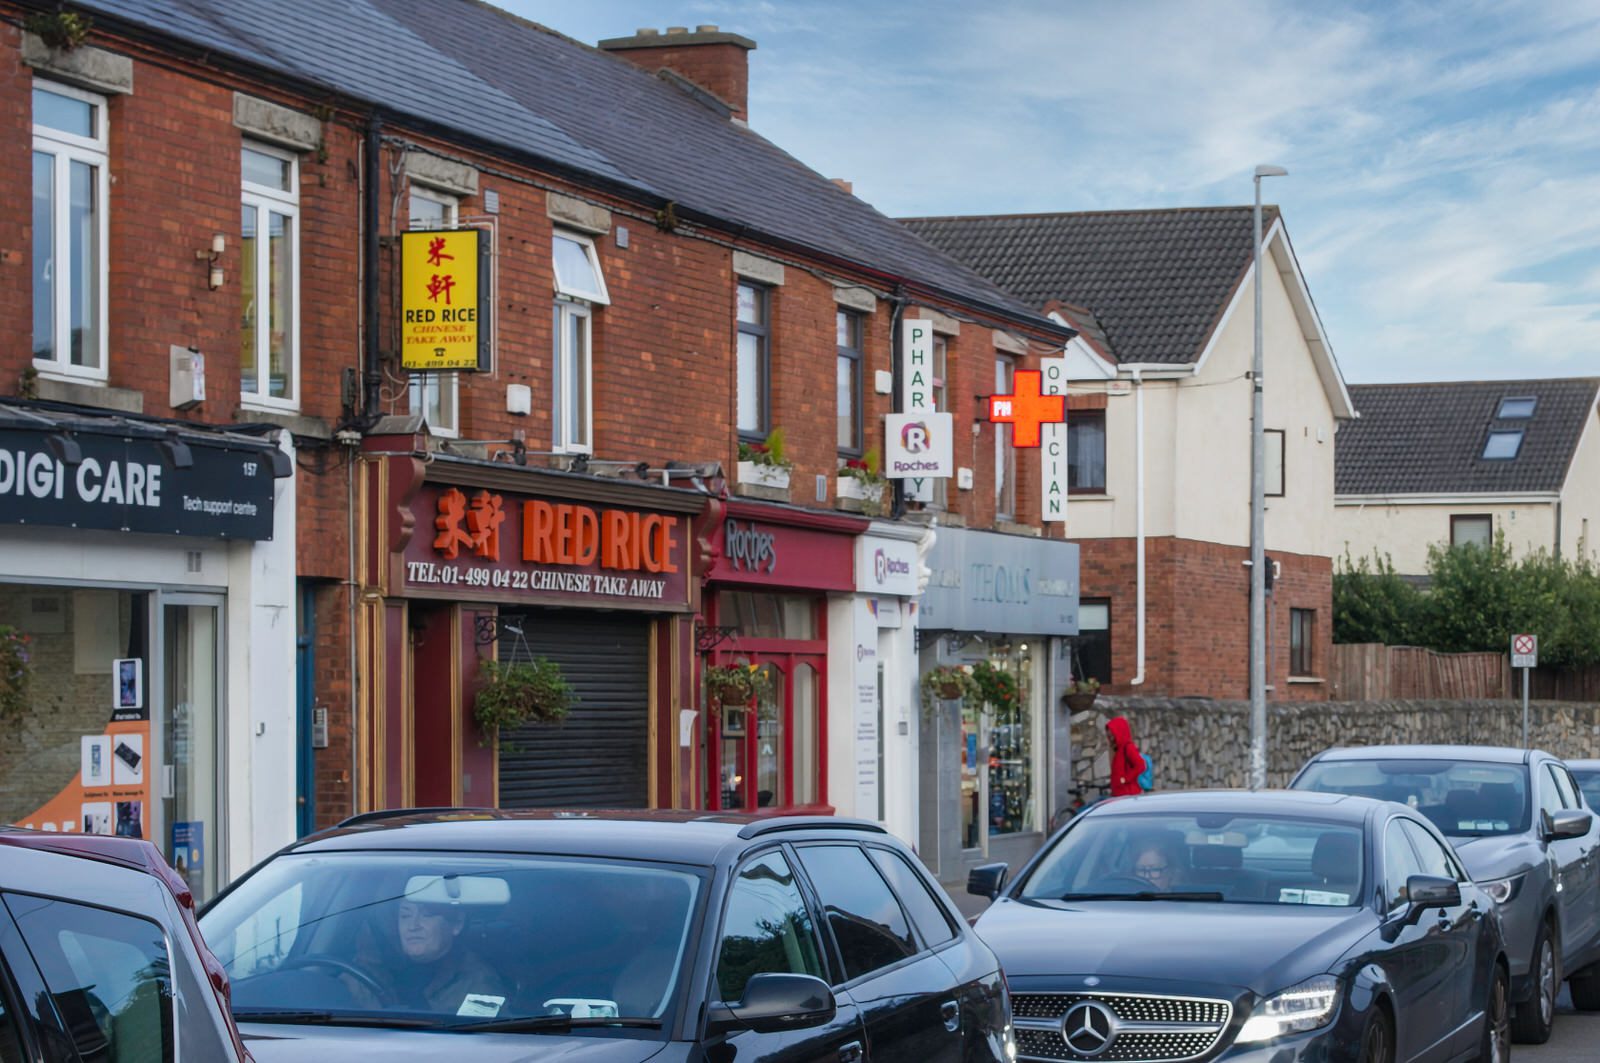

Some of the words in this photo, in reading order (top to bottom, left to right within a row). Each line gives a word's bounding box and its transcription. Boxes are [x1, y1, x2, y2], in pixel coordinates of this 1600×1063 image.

[406, 309, 436, 323] RED
[442, 308, 476, 322] RICE
[406, 335, 436, 344] TAKE
[439, 334, 475, 343] AWAY
[413, 324, 467, 333] CHINESE
[911, 328, 926, 493] PHARY
[1048, 366, 1061, 513] OPICIAN
[0, 448, 65, 499] DIGI
[76, 457, 161, 507] CARE
[243, 462, 258, 476] 157
[894, 460, 939, 472] Roches
[183, 495, 202, 511] Tech
[203, 499, 233, 516] support
[233, 501, 258, 516] centre
[522, 499, 599, 567] RED
[602, 509, 678, 574] RICE
[726, 518, 776, 573] Roches
[492, 569, 511, 588] 04
[512, 571, 529, 589] 22
[531, 570, 591, 593] CHINESE
[593, 575, 627, 596] TAKE
[628, 579, 666, 599] AWAY
